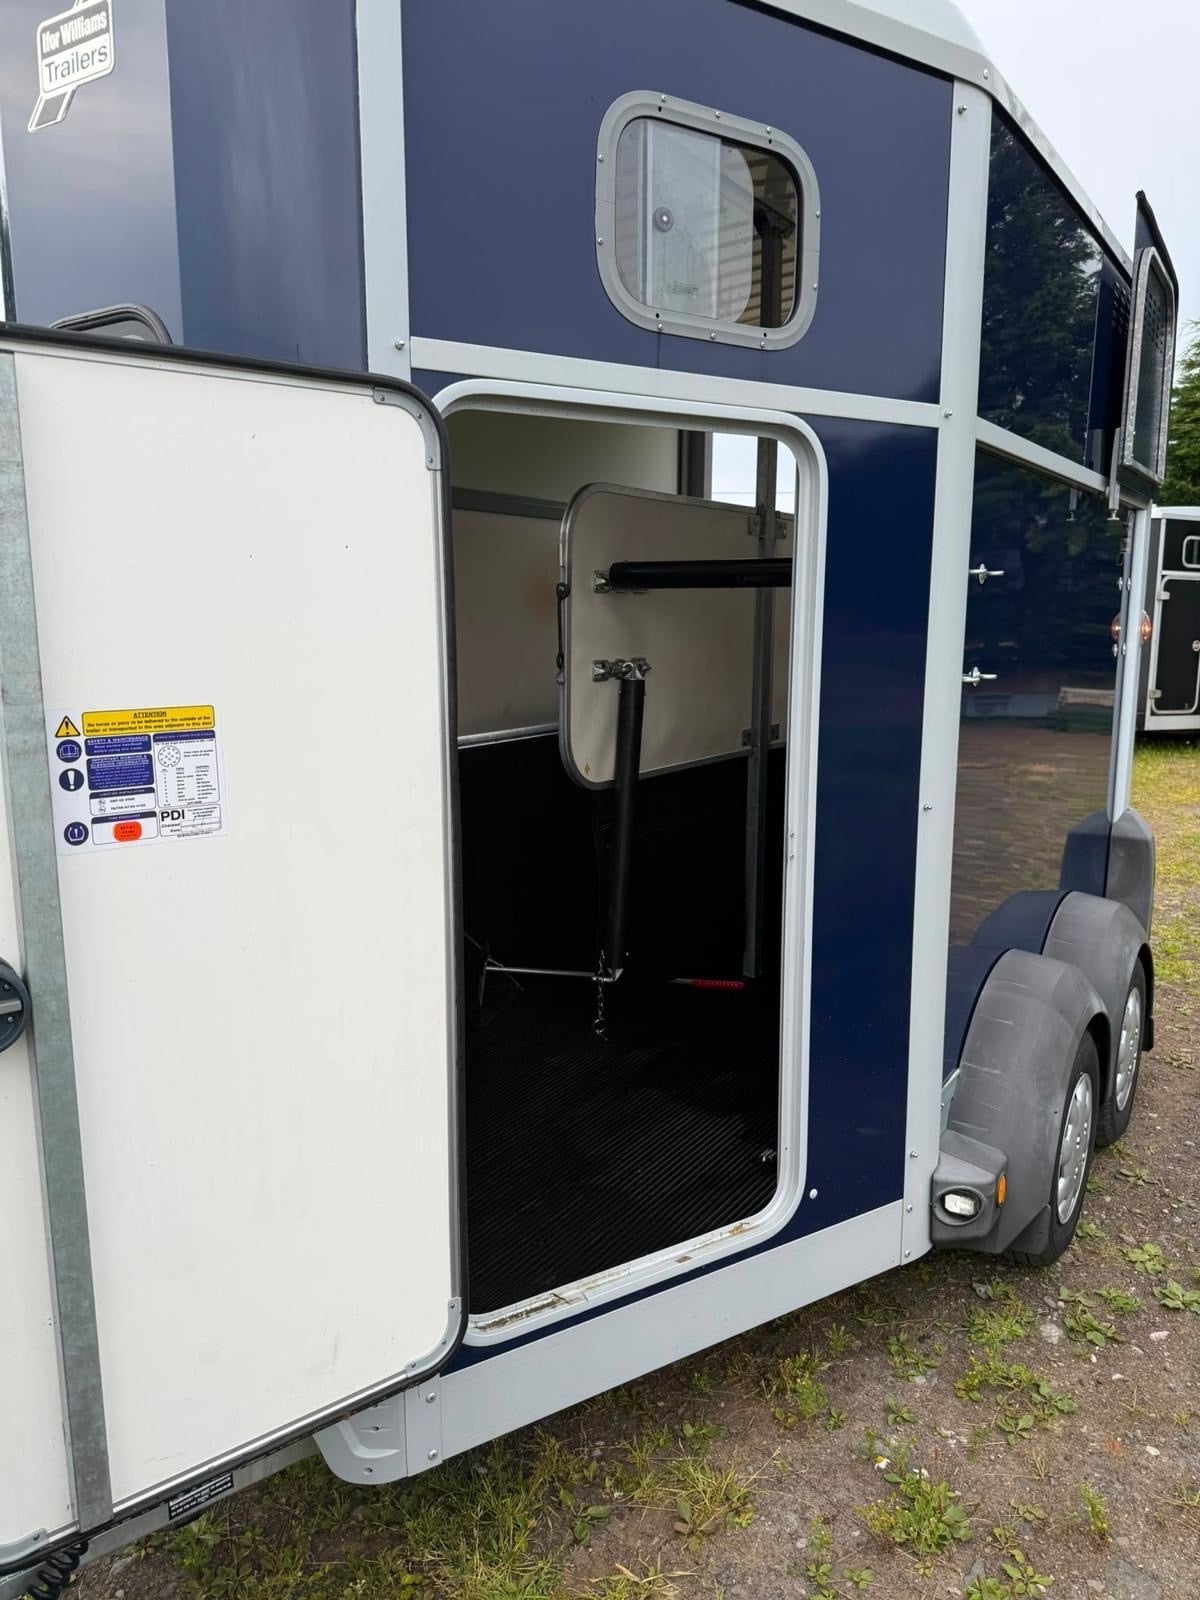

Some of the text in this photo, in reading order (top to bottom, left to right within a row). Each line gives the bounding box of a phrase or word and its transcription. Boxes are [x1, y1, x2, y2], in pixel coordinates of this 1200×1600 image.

[41, 11, 107, 53] Ifor Williams
[44, 45, 107, 83] Trailers
[133, 711, 167, 719] ATTENTION
[161, 809, 185, 822] PDI
